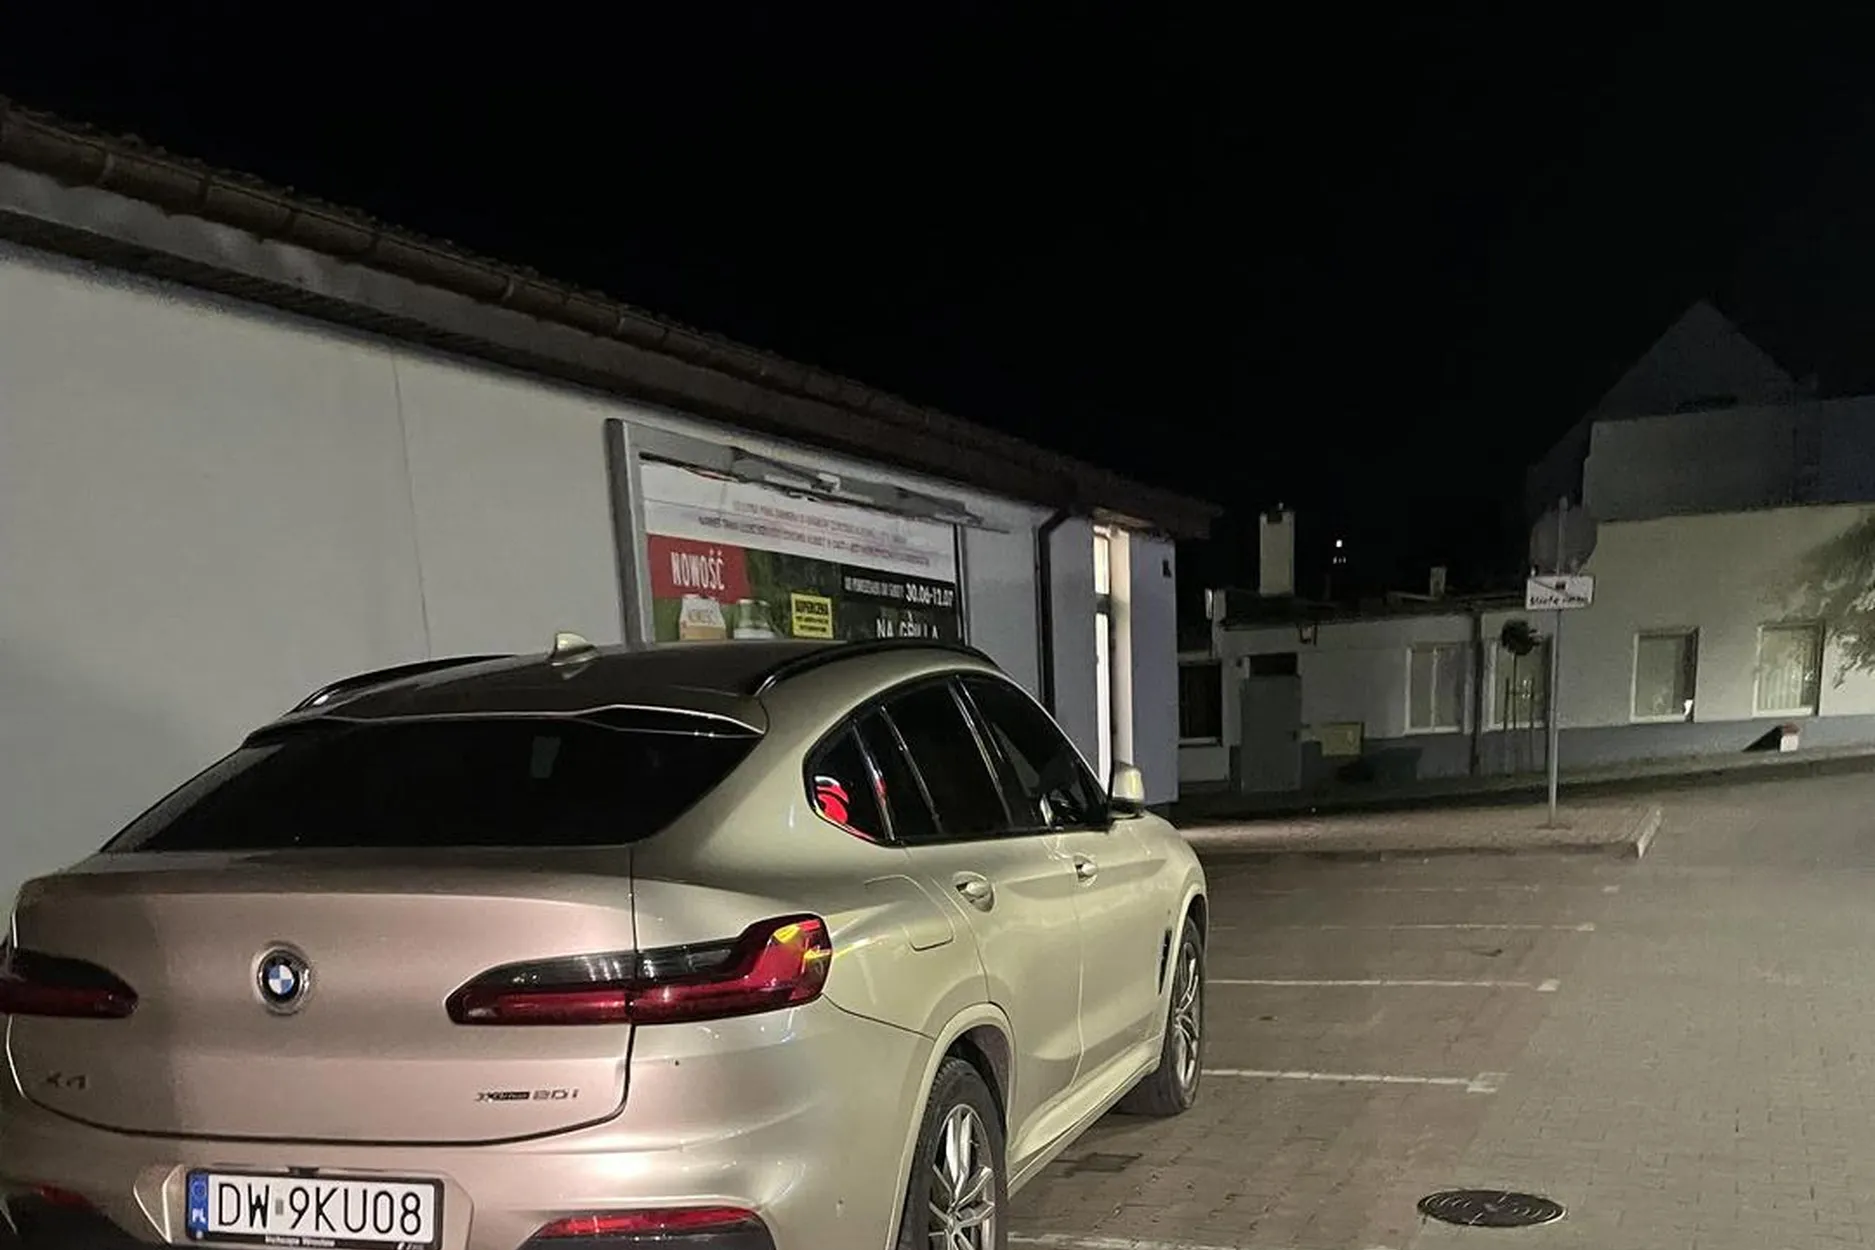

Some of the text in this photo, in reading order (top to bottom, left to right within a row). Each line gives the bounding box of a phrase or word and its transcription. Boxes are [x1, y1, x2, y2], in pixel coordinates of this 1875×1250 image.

[670, 549, 725, 591] NOWOŚĆ
[192, 1207, 206, 1224] PL
[217, 1182, 423, 1236] DW 9KU08
